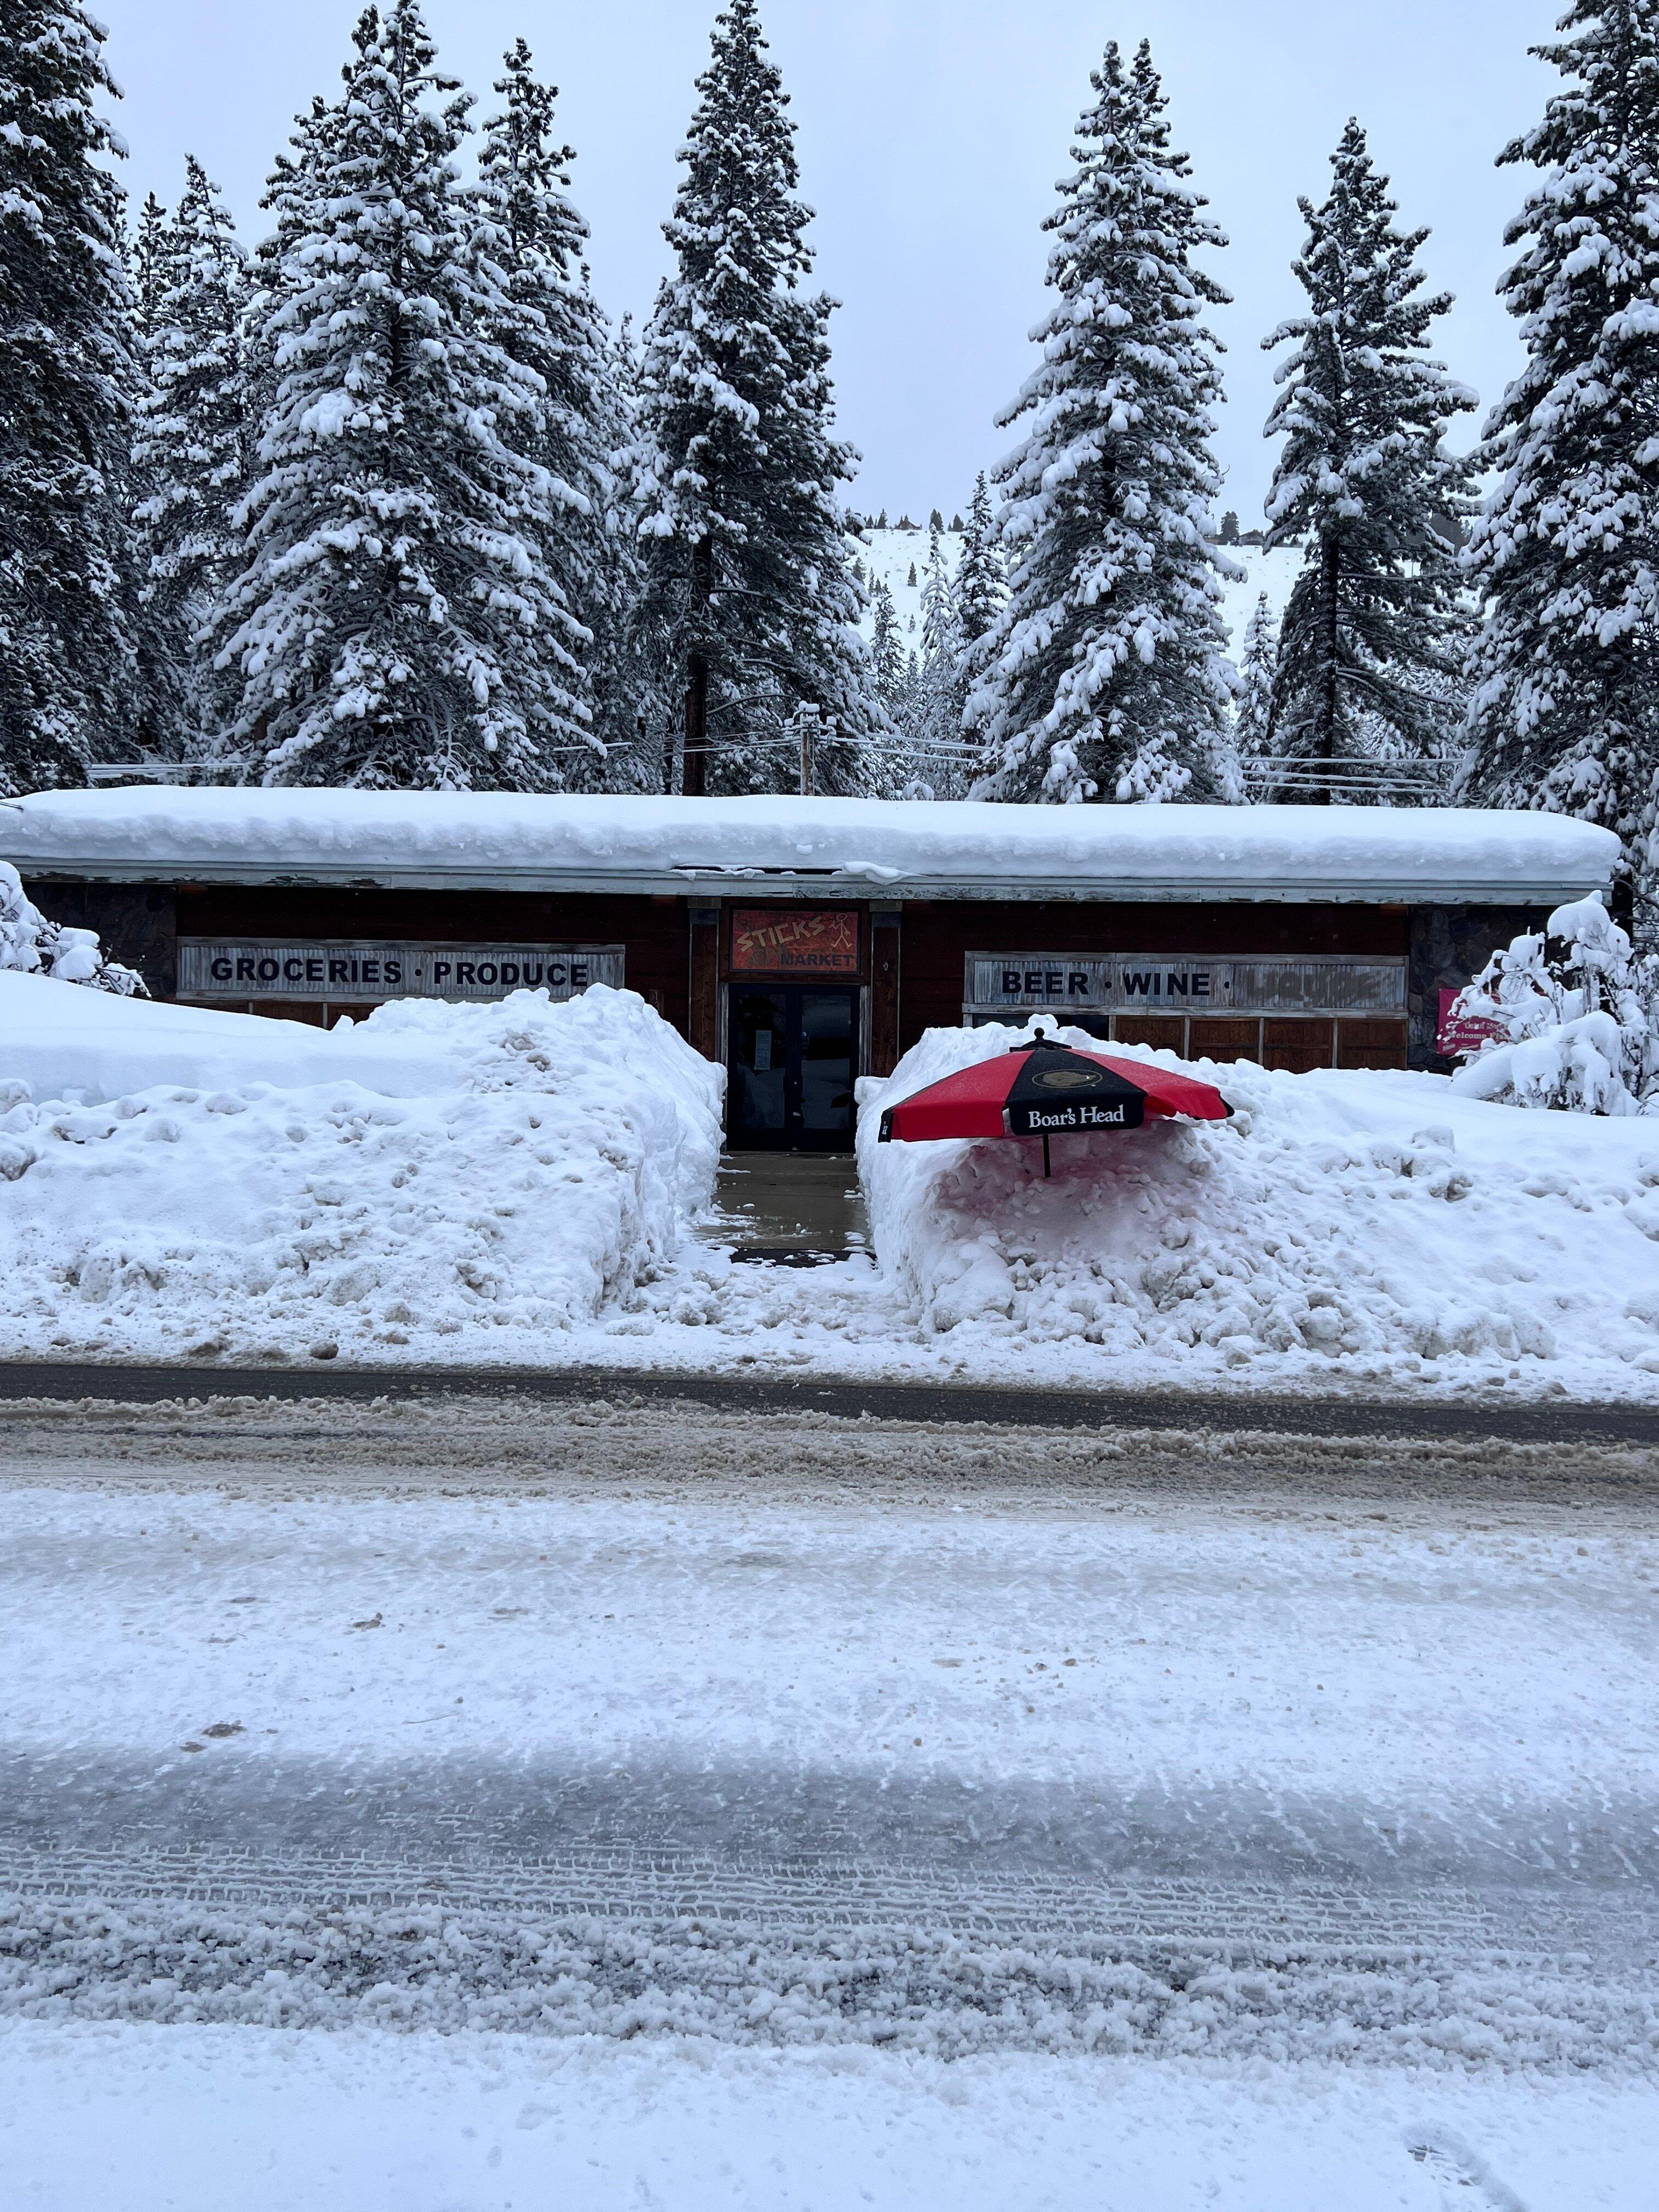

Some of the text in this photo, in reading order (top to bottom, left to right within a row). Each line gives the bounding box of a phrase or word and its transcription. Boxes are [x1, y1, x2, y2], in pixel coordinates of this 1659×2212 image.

[737, 916, 825, 952] STICKS
[211, 957, 588, 987] GROCERIES PRODUCE
[781, 953, 854, 967] MARKET
[1002, 970, 1210, 996] BEER WINE
[1028, 1104, 1125, 1128] Boar's Head
